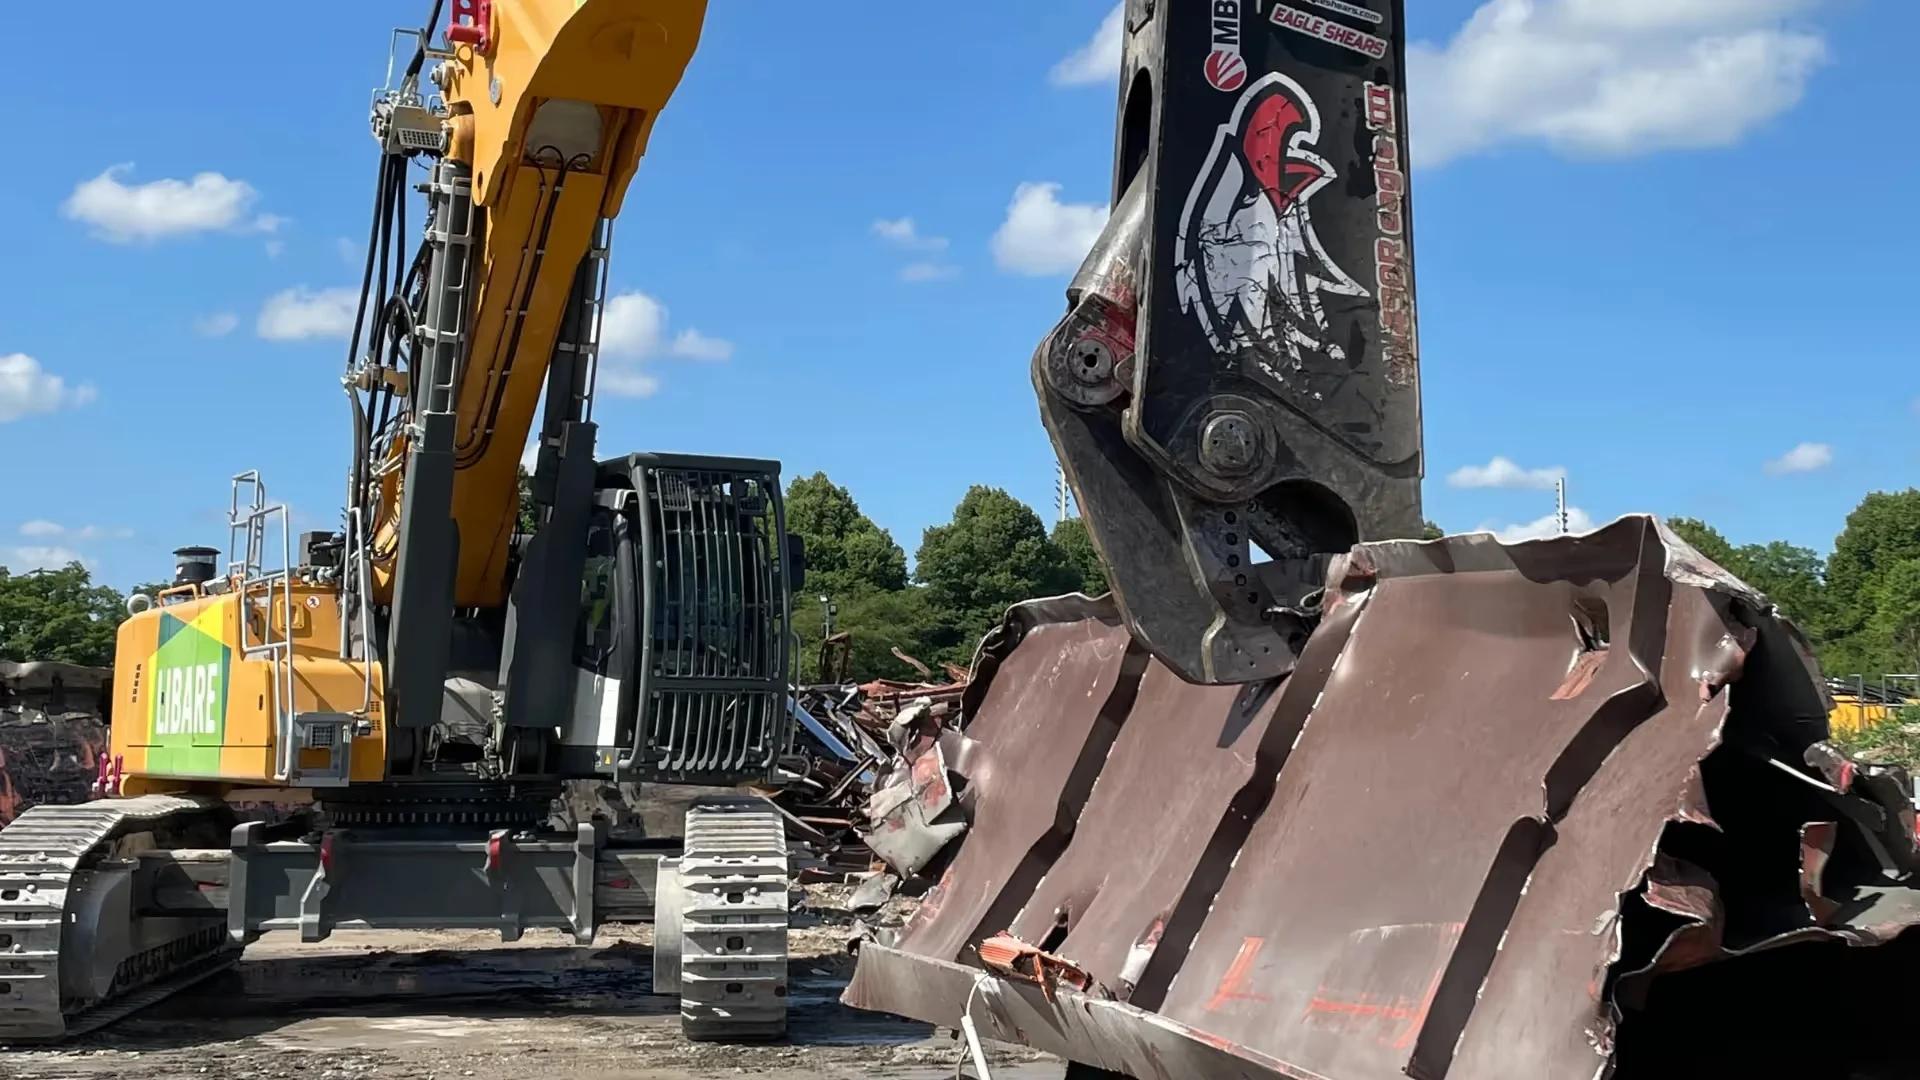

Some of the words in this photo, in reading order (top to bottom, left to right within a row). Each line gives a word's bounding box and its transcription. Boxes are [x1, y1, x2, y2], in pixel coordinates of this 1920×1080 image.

[1213, 0, 1239, 45] MB
[1272, 7, 1325, 35] EAGLE
[1324, 24, 1386, 56] SHEARS
[156, 662, 217, 735] LIBARE
